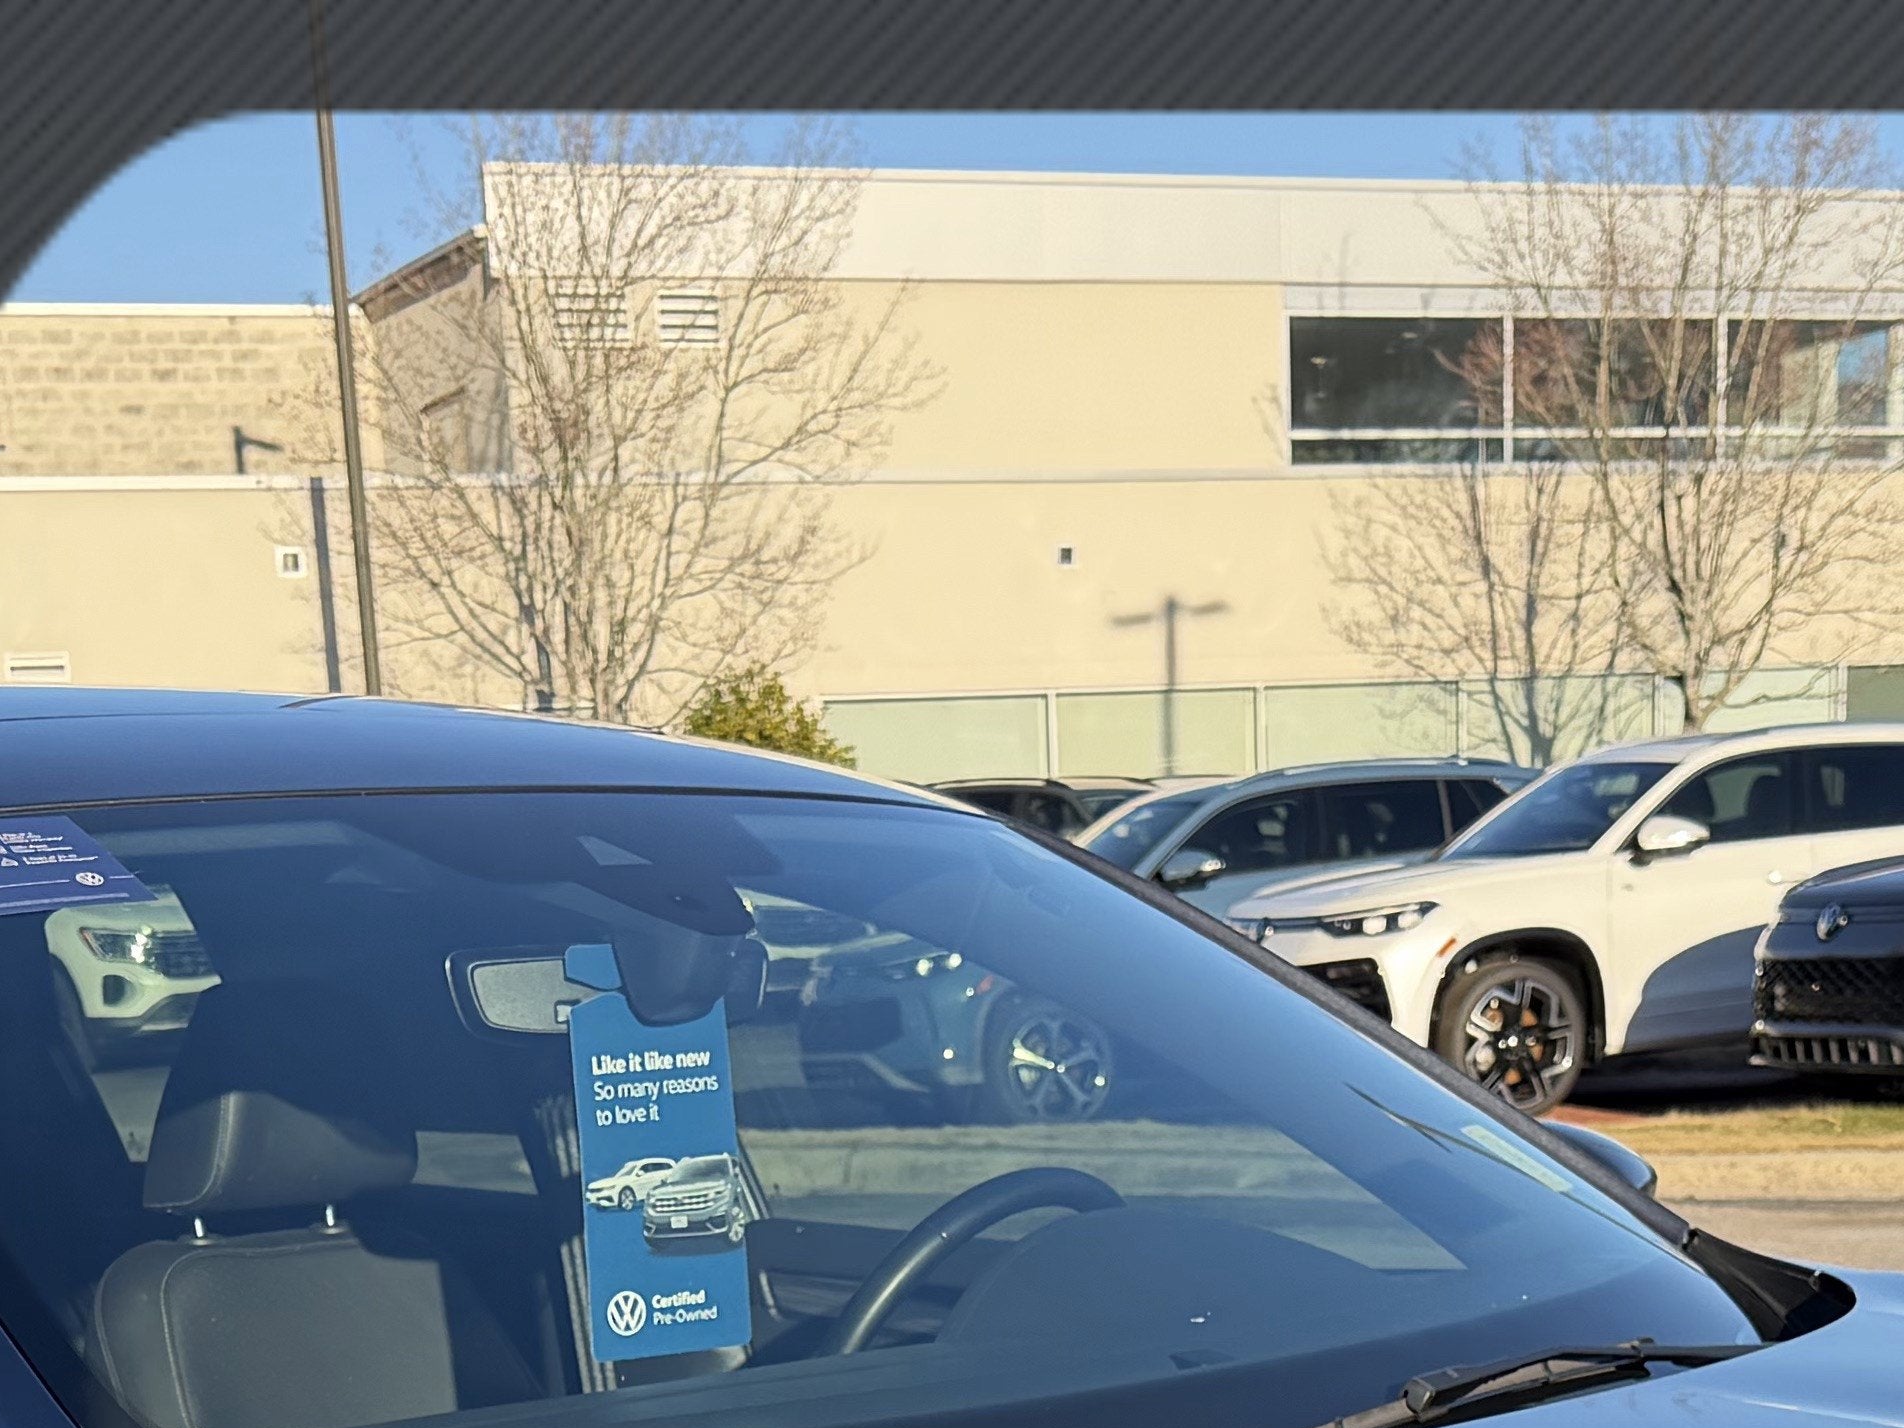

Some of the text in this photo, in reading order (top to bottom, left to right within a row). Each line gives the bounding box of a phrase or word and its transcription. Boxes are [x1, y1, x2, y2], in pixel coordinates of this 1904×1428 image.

[591, 1050, 711, 1076] Like it like new
[593, 1075, 719, 1101] So many reasons
[595, 1102, 660, 1127] to love it
[651, 1289, 706, 1309] Certified
[653, 1305, 718, 1326] Pre-Owned
